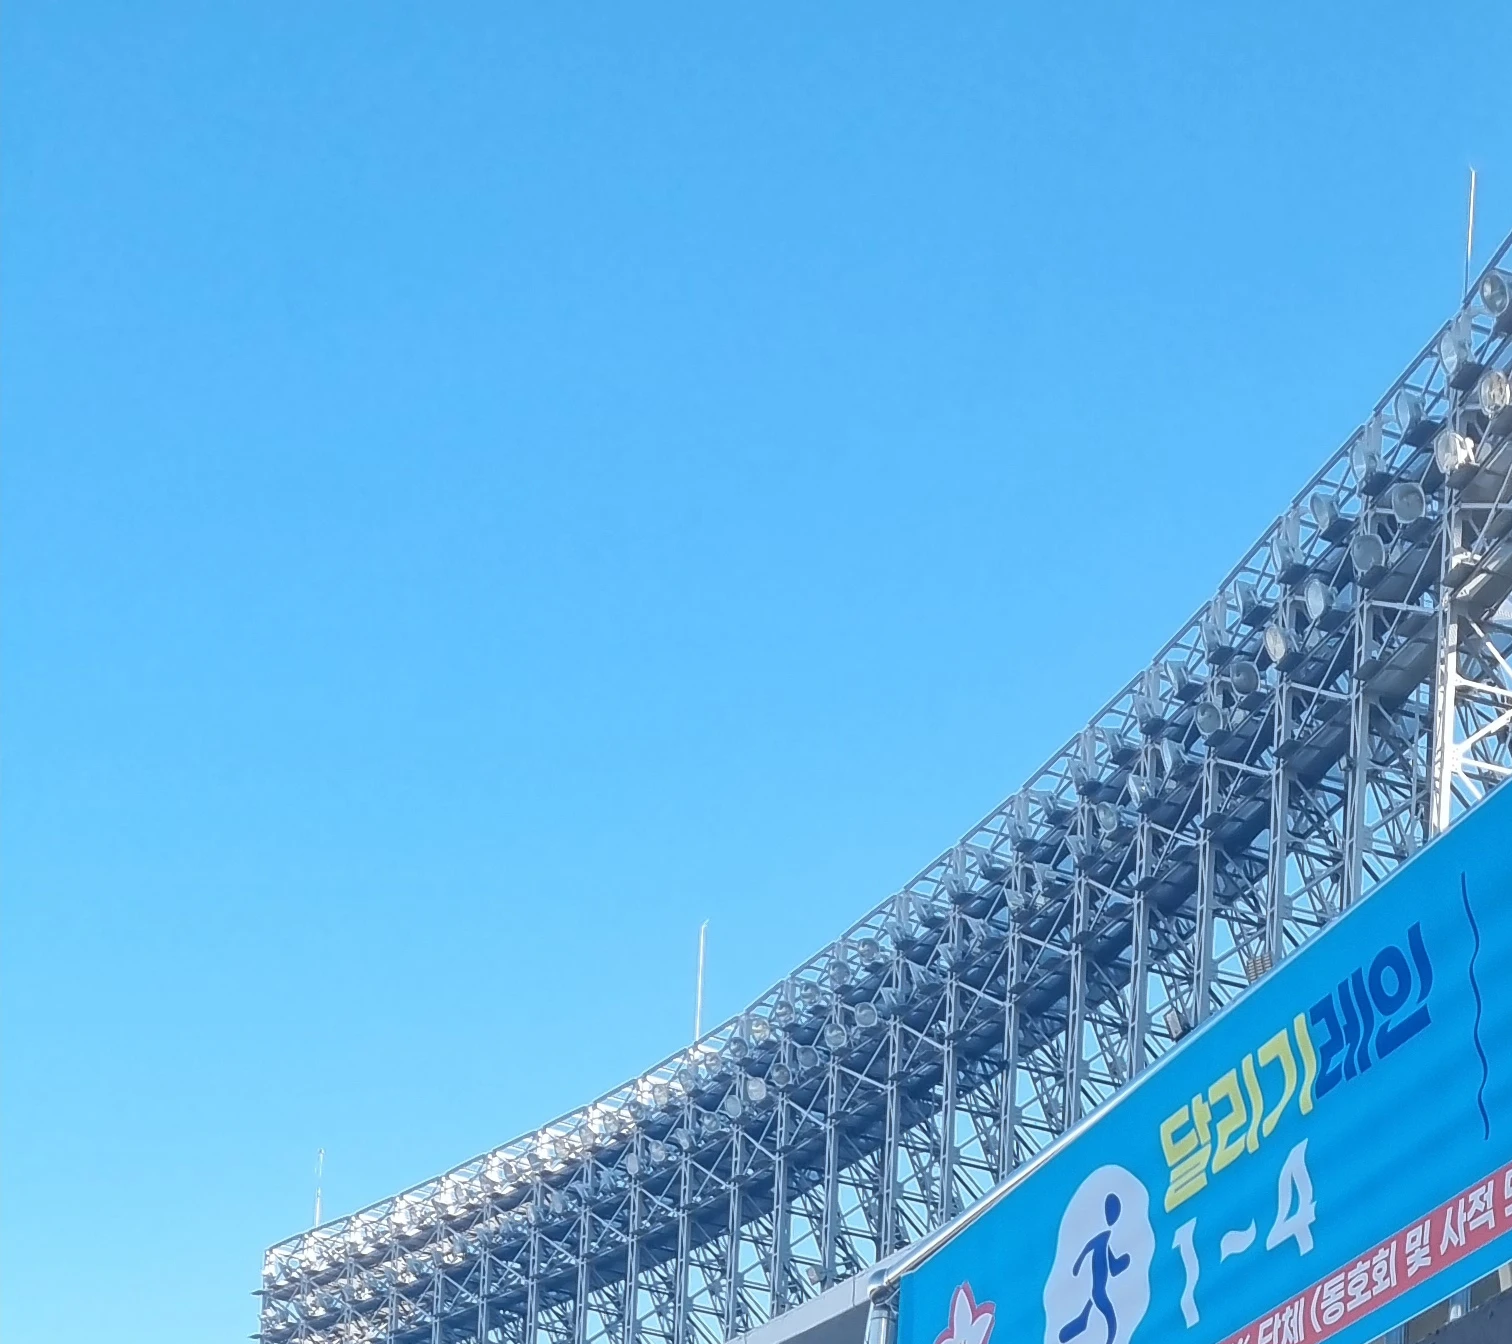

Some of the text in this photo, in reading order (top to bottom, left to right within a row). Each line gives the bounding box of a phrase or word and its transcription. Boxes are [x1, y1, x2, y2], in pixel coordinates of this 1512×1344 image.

[1159, 920, 1435, 1214] 달리기레인
[1405, 1219, 1432, 1277] 및
[1439, 1179, 1496, 1256] 사적
